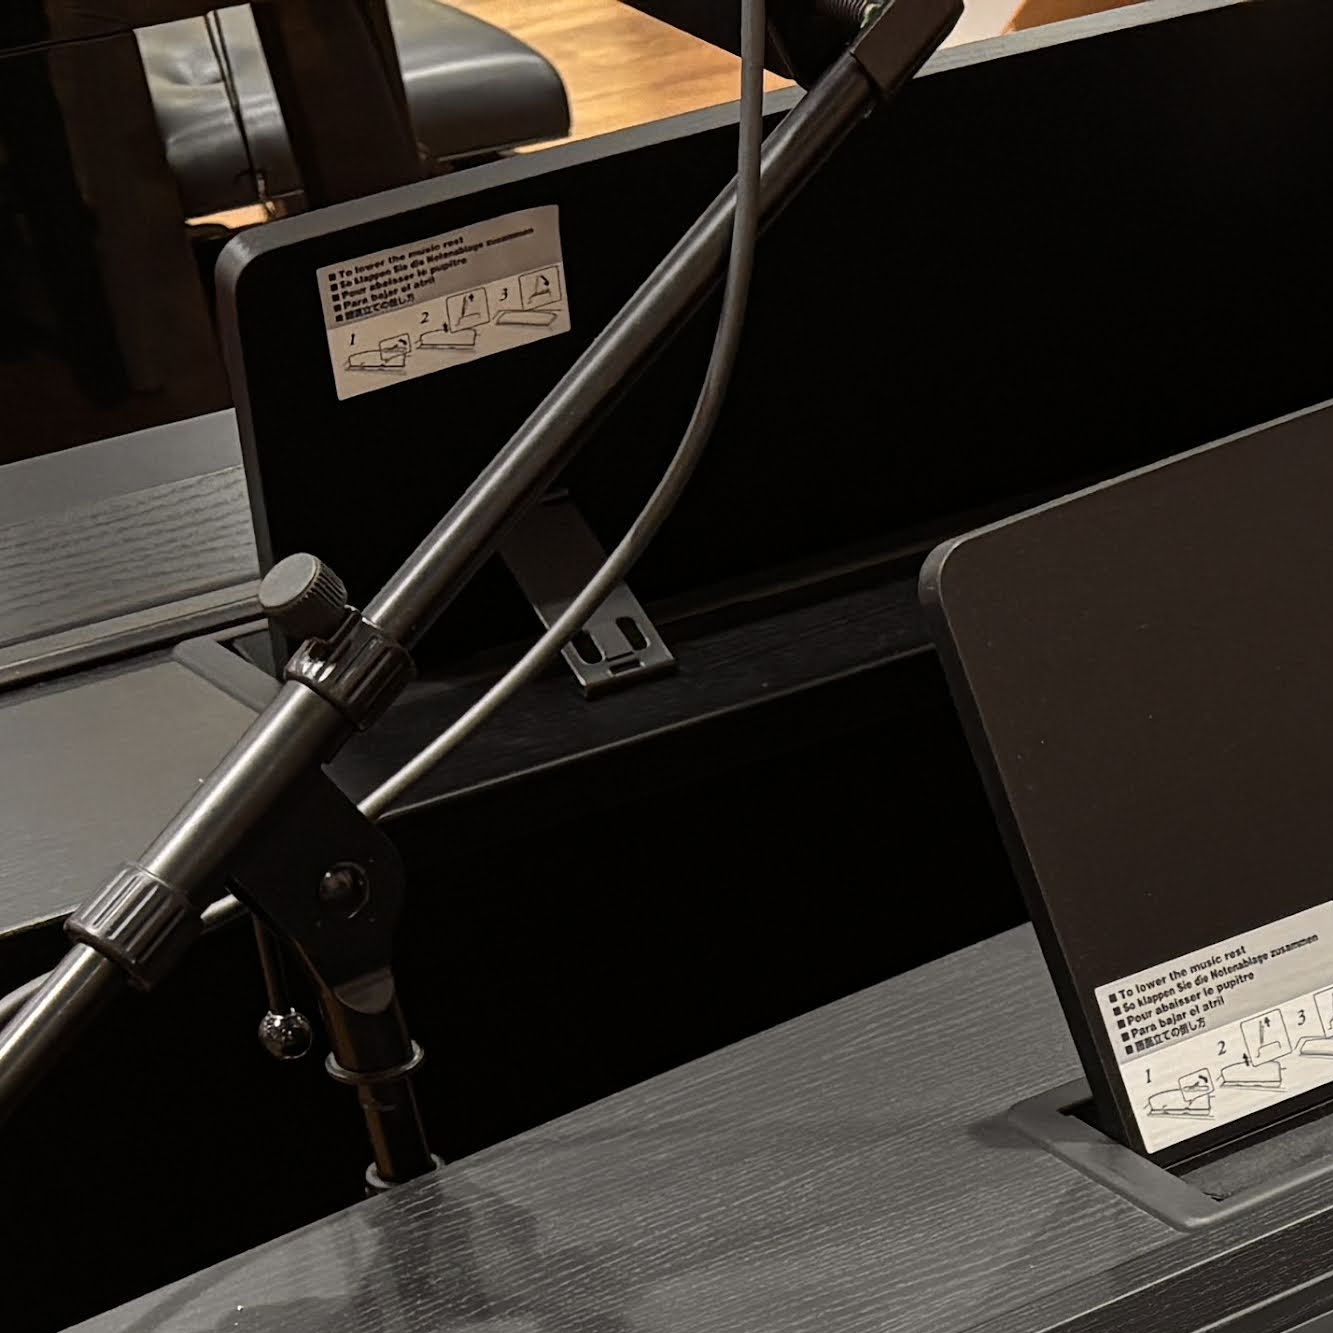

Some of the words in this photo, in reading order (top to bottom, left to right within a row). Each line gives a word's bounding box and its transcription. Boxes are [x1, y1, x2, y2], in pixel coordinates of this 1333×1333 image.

[355, 260, 386, 274] lower
[388, 252, 406, 264] the
[499, 288, 508, 301] 3
[420, 312, 430, 324] 2
[1119, 988, 1134, 1000] To
[1136, 975, 1167, 997] lower
[1169, 967, 1188, 982] the
[1190, 954, 1223, 974] music
[1225, 945, 1246, 961] rest
[1123, 1001, 1137, 1013] So
[1138, 984, 1176, 1009] klappen
[1177, 979, 1193, 993] Sie
[1194, 972, 1209, 987] die
[1210, 951, 1269, 981] Notenablage
[1270, 934, 1319, 958] zusammen
[1127, 1010, 1153, 1026] Pour
[1155, 990, 1201, 1015] abaisser
[1203, 985, 1215, 997] le
[1216, 971, 1255, 994] pupitre
[1131, 1022, 1157, 1039] Para
[1159, 1010, 1188, 1031] bajar
[1190, 1005, 1201, 1017] el
[1202, 995, 1225, 1012] atril
[1297, 1009, 1307, 1026] 3
[1217, 1040, 1227, 1056] 2
[1145, 1068, 1153, 1084] 1
